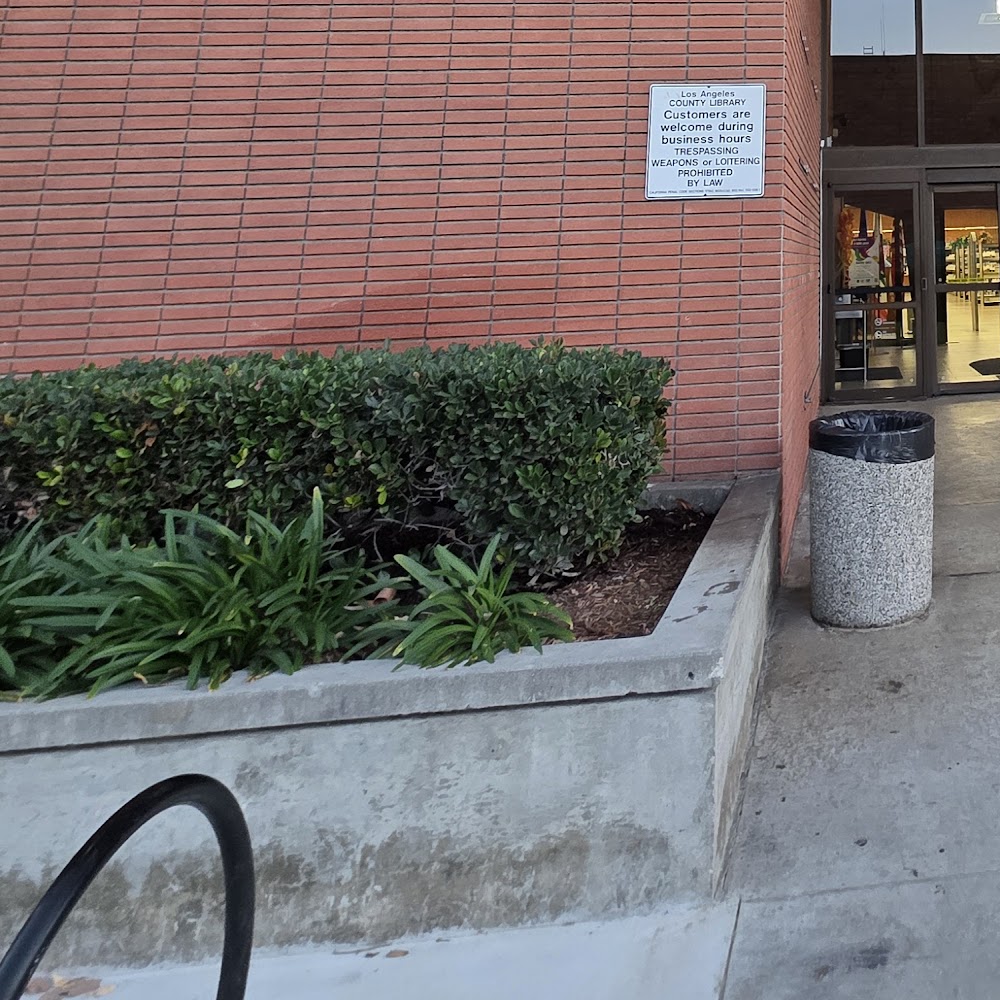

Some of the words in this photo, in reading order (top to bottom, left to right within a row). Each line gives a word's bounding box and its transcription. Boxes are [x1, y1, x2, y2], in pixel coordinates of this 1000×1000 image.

[700, 90, 735, 99] Angeles
[669, 99, 706, 107] COUNTY
[664, 110, 727, 119] Customers
[732, 110, 751, 119] are
[660, 122, 713, 132] welcome
[718, 122, 754, 132] during
[661, 135, 714, 145] business
[719, 134, 752, 143] hours
[674, 147, 739, 156] TRESPASSING
[651, 159, 699, 167] WEAPONS
[715, 157, 760, 166] LOITERING
[677, 168, 733, 177] PROHIBITED
[687, 179, 699, 187] BY
[703, 179, 723, 187] LAW
